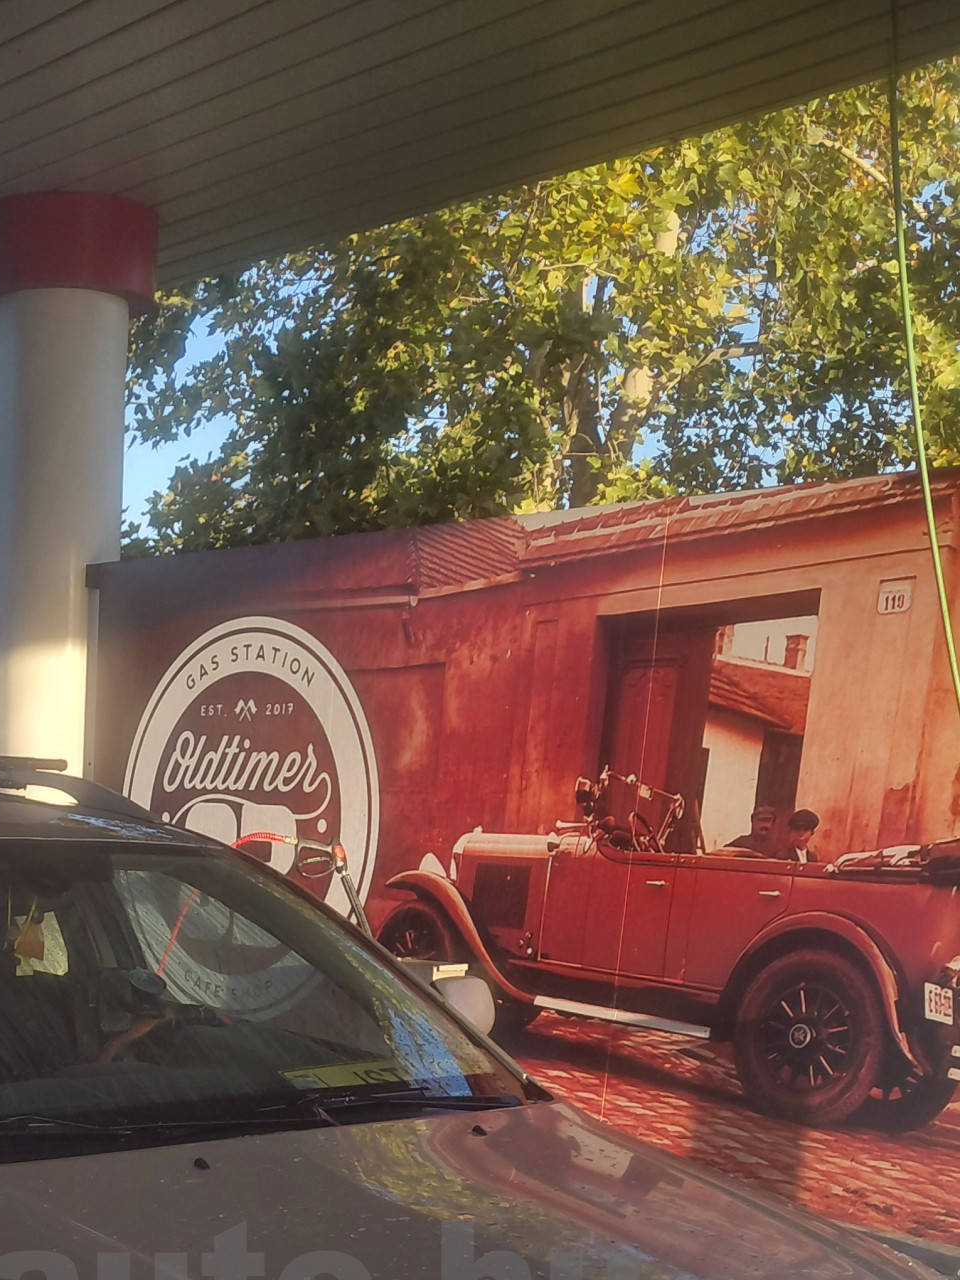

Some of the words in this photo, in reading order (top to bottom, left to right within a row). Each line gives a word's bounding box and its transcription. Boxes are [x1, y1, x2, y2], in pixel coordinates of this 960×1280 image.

[185, 654, 220, 691] GAS
[230, 643, 316, 688] STATION
[200, 703, 228, 717] EST.
[265, 702, 295, 716] 2017
[162, 730, 331, 794] Oldtimer
